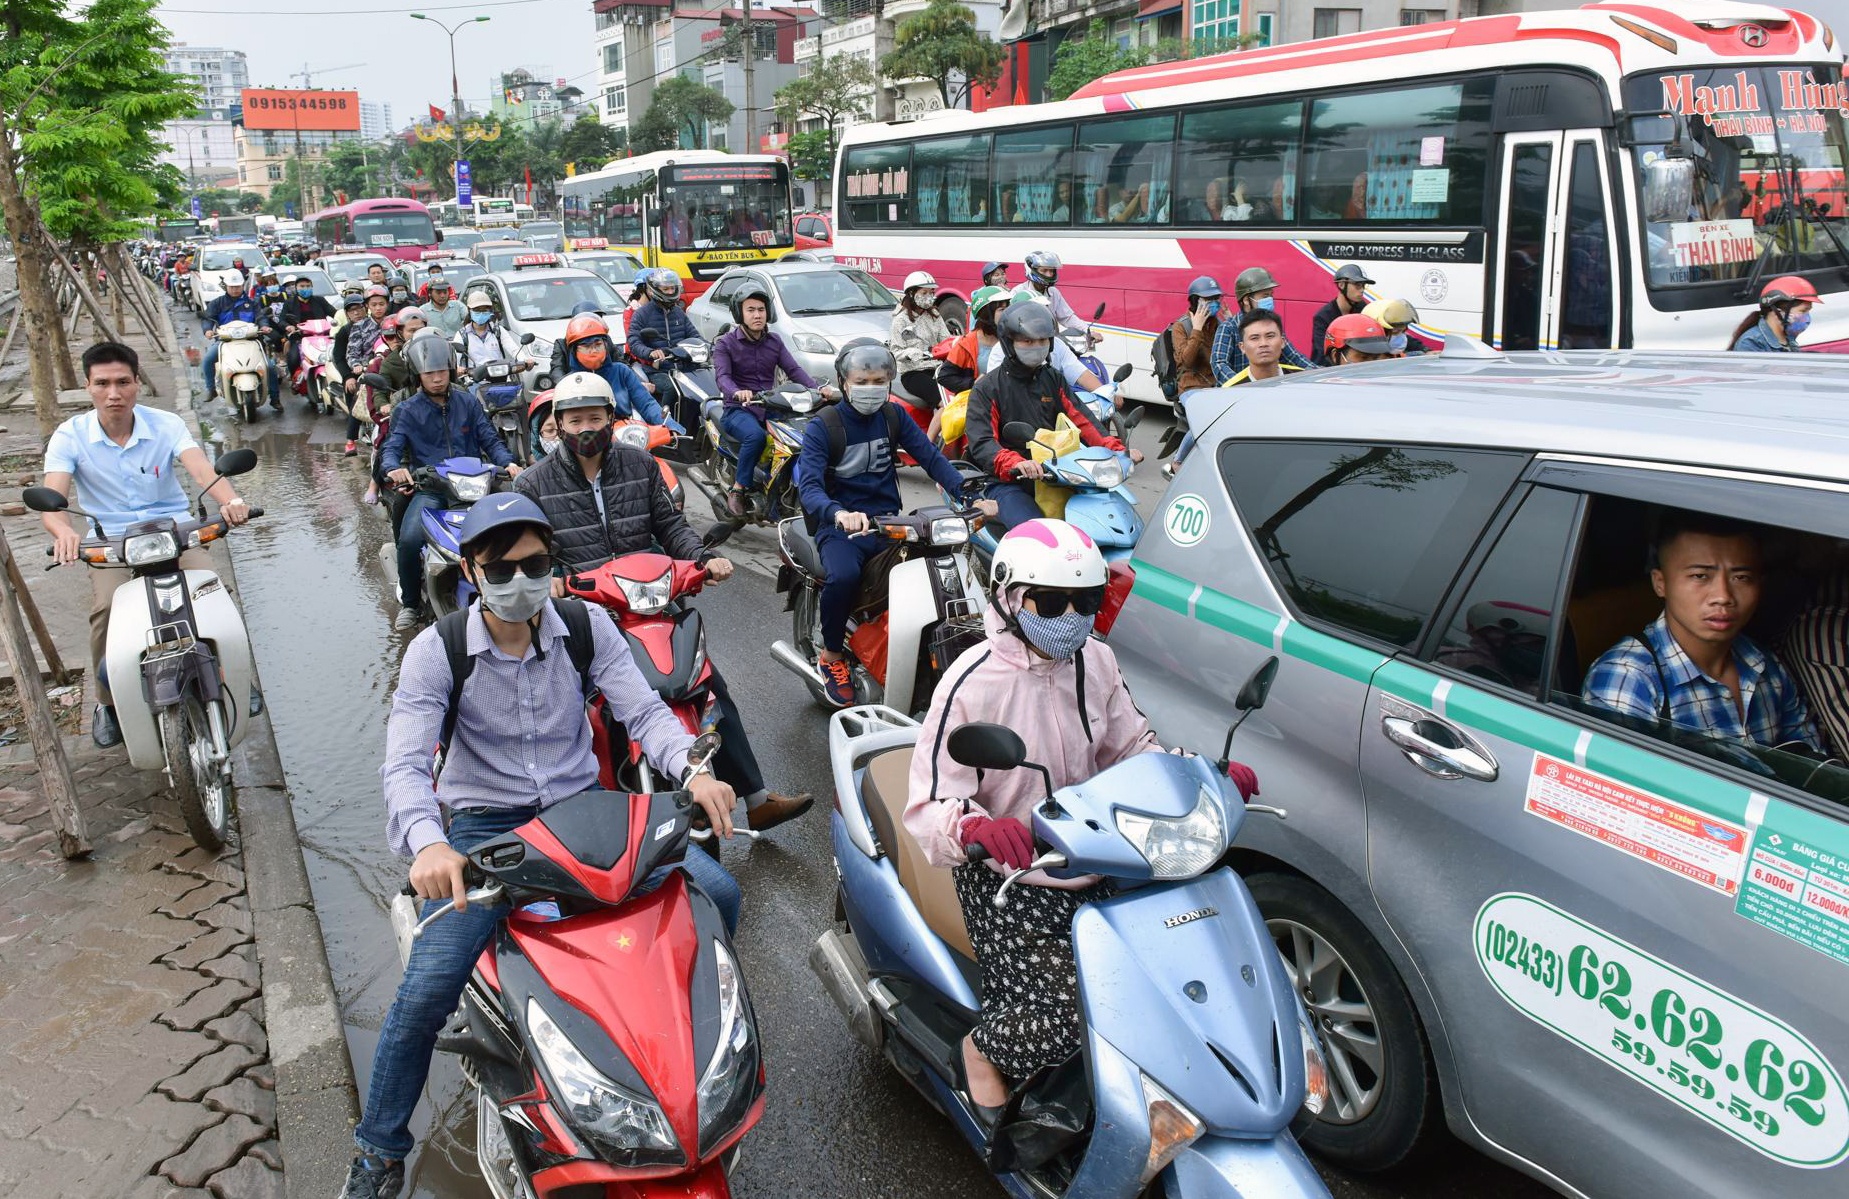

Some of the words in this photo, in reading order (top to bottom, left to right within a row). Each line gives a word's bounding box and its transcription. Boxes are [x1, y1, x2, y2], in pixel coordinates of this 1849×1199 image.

[250, 98, 346, 110] 0915344598
[1660, 71, 1760, 126] Mạnh
[1778, 71, 1849, 118] Hùng
[1712, 115, 1743, 137] THÁI
[1744, 114, 1774, 135] BÌNH
[1789, 112, 1805, 132] HÀ
[519, 255, 536, 264] Taxi
[741, 251, 755, 259] BUS
[1326, 245, 1355, 257] AERO
[1358, 246, 1404, 258] EXPRESS
[1409, 246, 1465, 260] HI-CLASS
[1677, 234, 1717, 266] THÁI
[1720, 232, 1755, 263] BÌNH
[1171, 503, 1204, 537] 700
[1793, 842, 1817, 859] BẢNG
[1820, 852, 1834, 866] GIÁ
[1754, 868, 1794, 893] 6.000đ
[1164, 906, 1219, 928] HONDA
[1485, 919, 1564, 997] (02433)
[1567, 944, 1827, 1127] 62.62.62
[1611, 1026, 1781, 1137] 59.59.59
